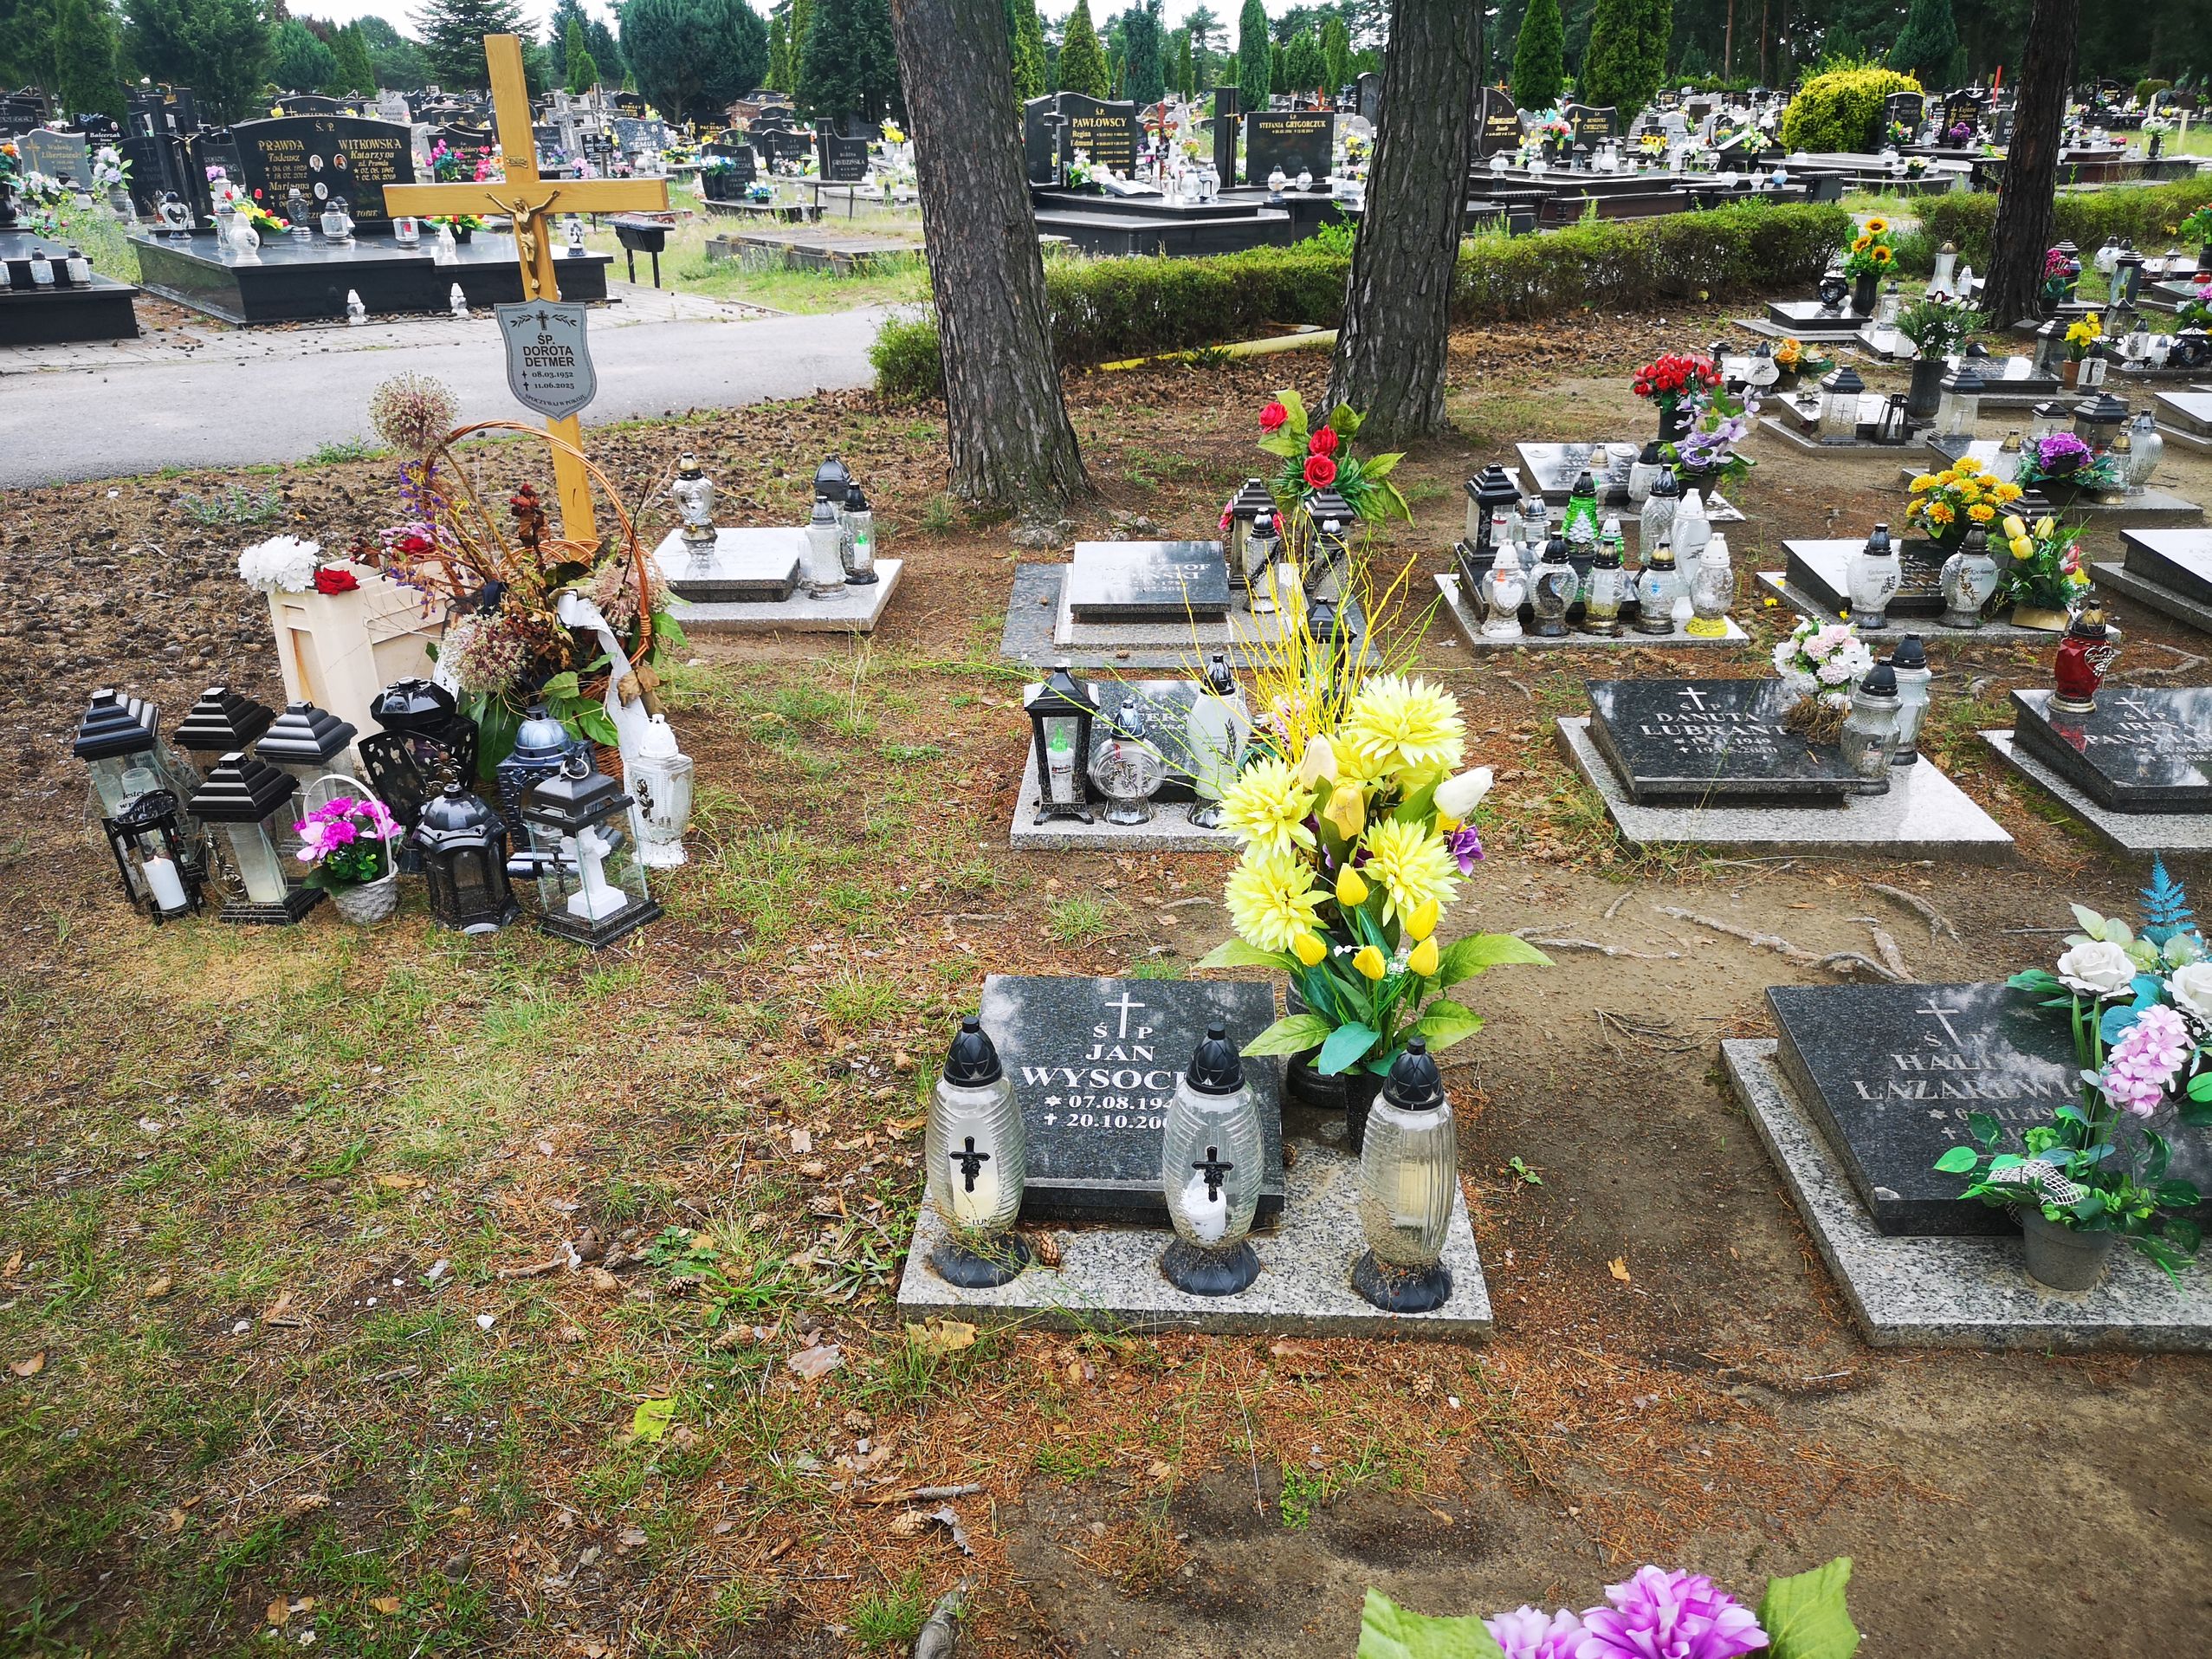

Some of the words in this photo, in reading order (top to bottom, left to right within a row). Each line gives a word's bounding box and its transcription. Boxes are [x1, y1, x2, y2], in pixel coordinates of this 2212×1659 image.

[1072, 118, 1127, 127] PAWŁOWSCY
[258, 139, 305, 151] PRAWDA
[338, 139, 402, 150] WITKOWSKA
[268, 152, 301, 163] Tadeusz
[351, 150, 394, 160] Katarzyna
[537, 332, 555, 345] ŚP.
[522, 346, 574, 356] DOROTA
[525, 356, 575, 367] DETMER
[532, 370, 573, 379] 08.03.1952
[1655, 713, 1760, 722] DANUTA
[1640, 724, 1789, 736] LUBRANT
[2118, 721, 2201, 730] IRENA
[1092, 1021, 1108, 1039] Ś
[1137, 1026, 1154, 1039] P
[1085, 1044, 1155, 1062] JAN
[1020, 1066, 1187, 1091] WYSOC
[1068, 1095, 1174, 1111] 07.08.194
[1065, 1113, 1168, 1130] 20.10.20
